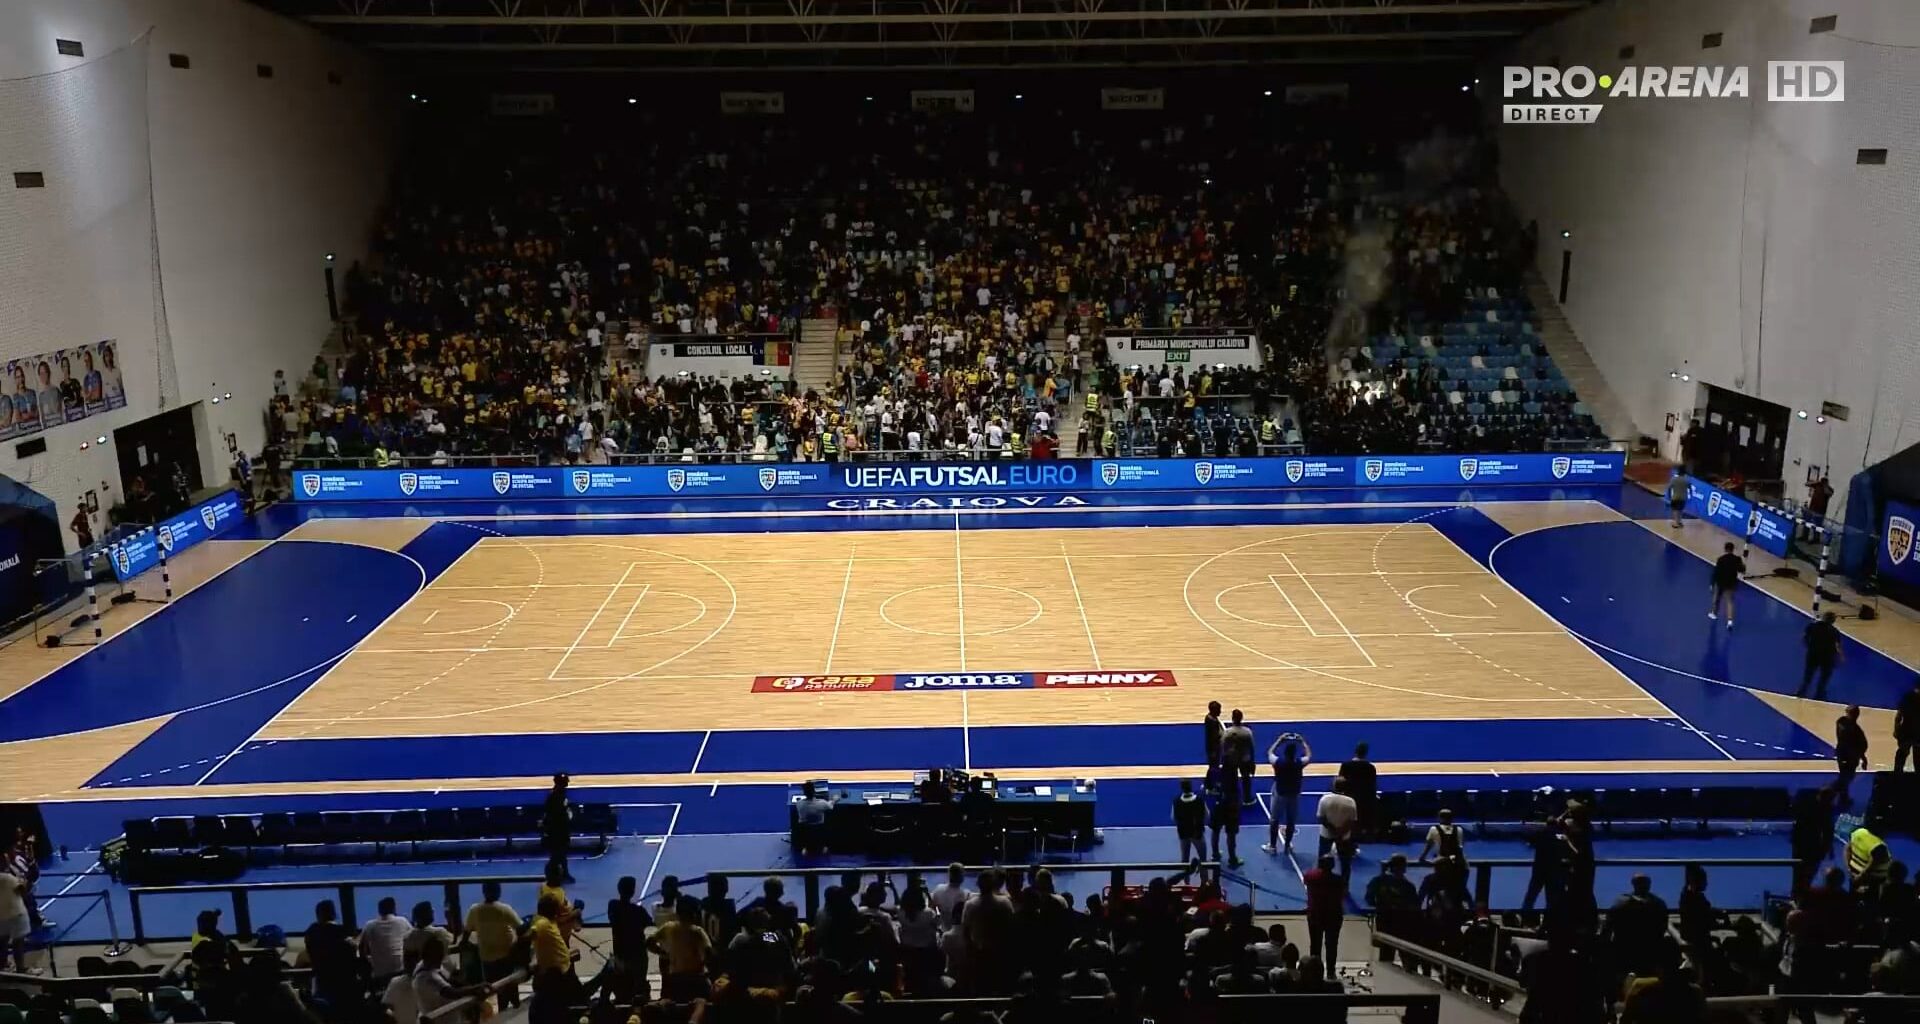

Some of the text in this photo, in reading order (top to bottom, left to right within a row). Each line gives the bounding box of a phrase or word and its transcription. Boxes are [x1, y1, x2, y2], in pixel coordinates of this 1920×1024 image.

[726, 345, 747, 354] LOCAL
[1168, 351, 1189, 360] EXIT
[844, 465, 1076, 487] UEFA FUTSAL EURO
[826, 496, 1091, 509] CRAIOVA
